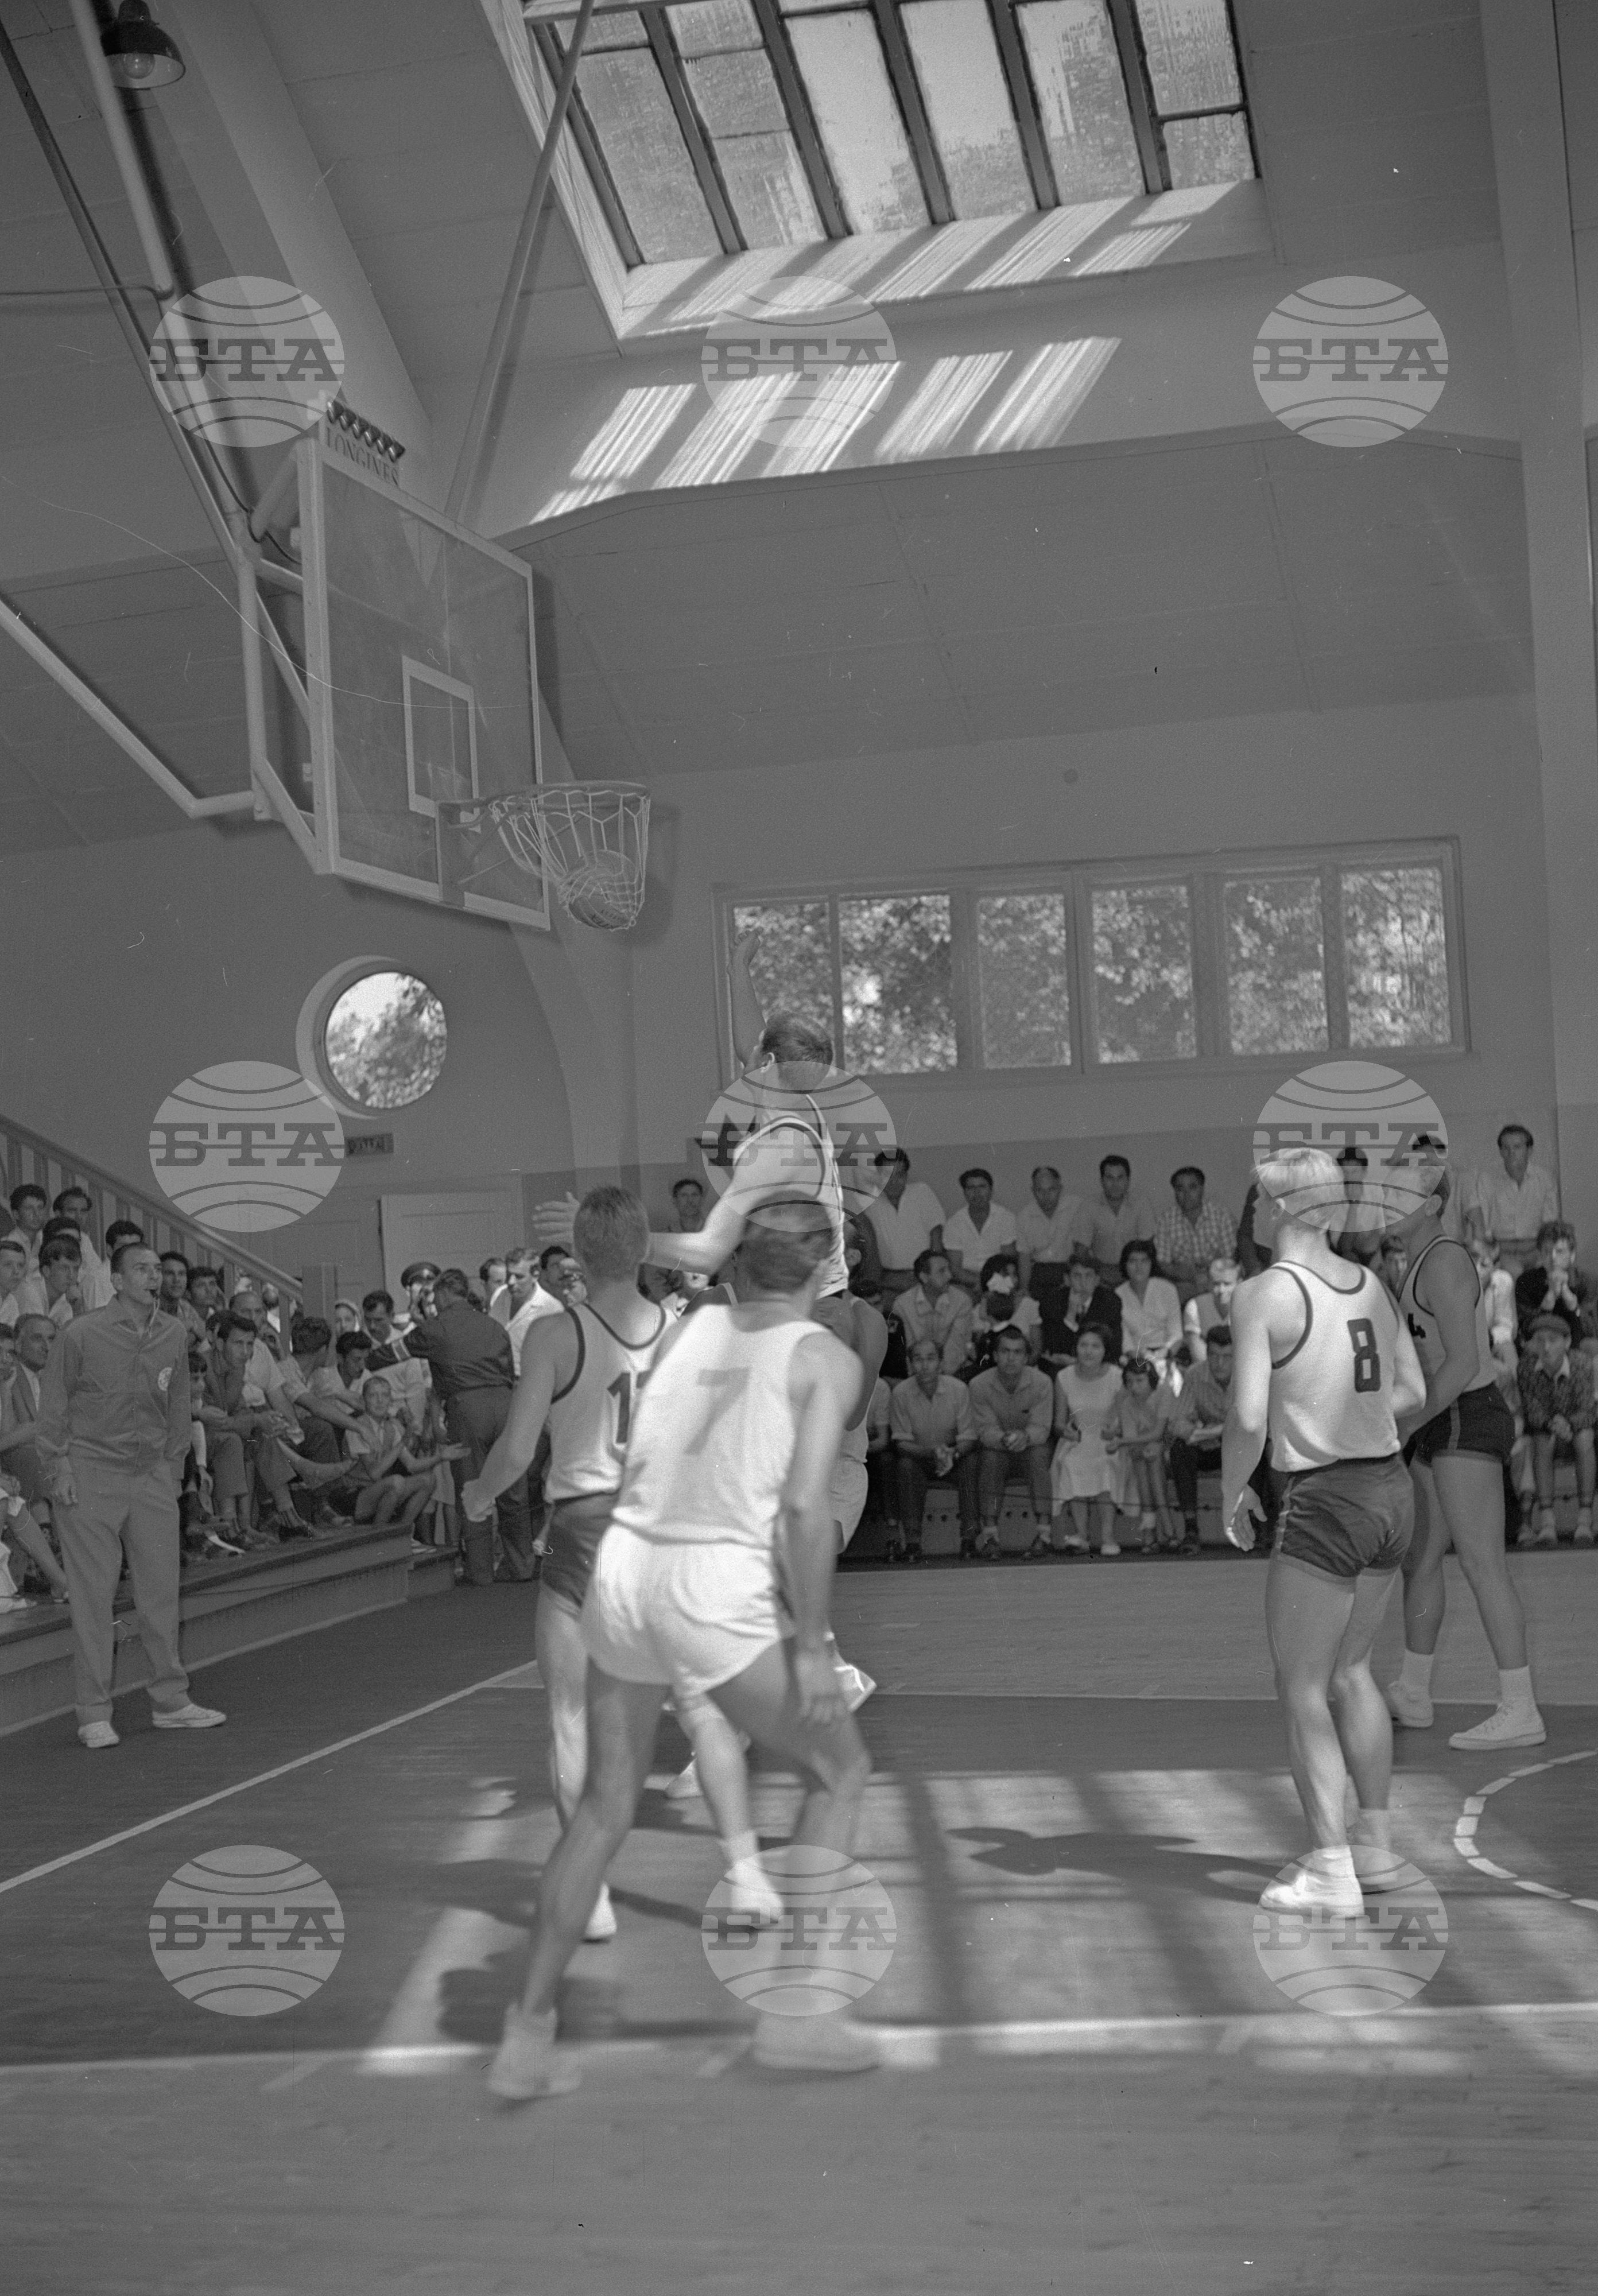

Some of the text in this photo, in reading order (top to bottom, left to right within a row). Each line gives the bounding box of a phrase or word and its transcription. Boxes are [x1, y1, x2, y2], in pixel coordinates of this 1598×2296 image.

[327, 426, 399, 486] LONGINES
[1347, 1318, 1381, 1393] 8
[607, 1371, 651, 1444] 1
[683, 1367, 751, 1455] 7
